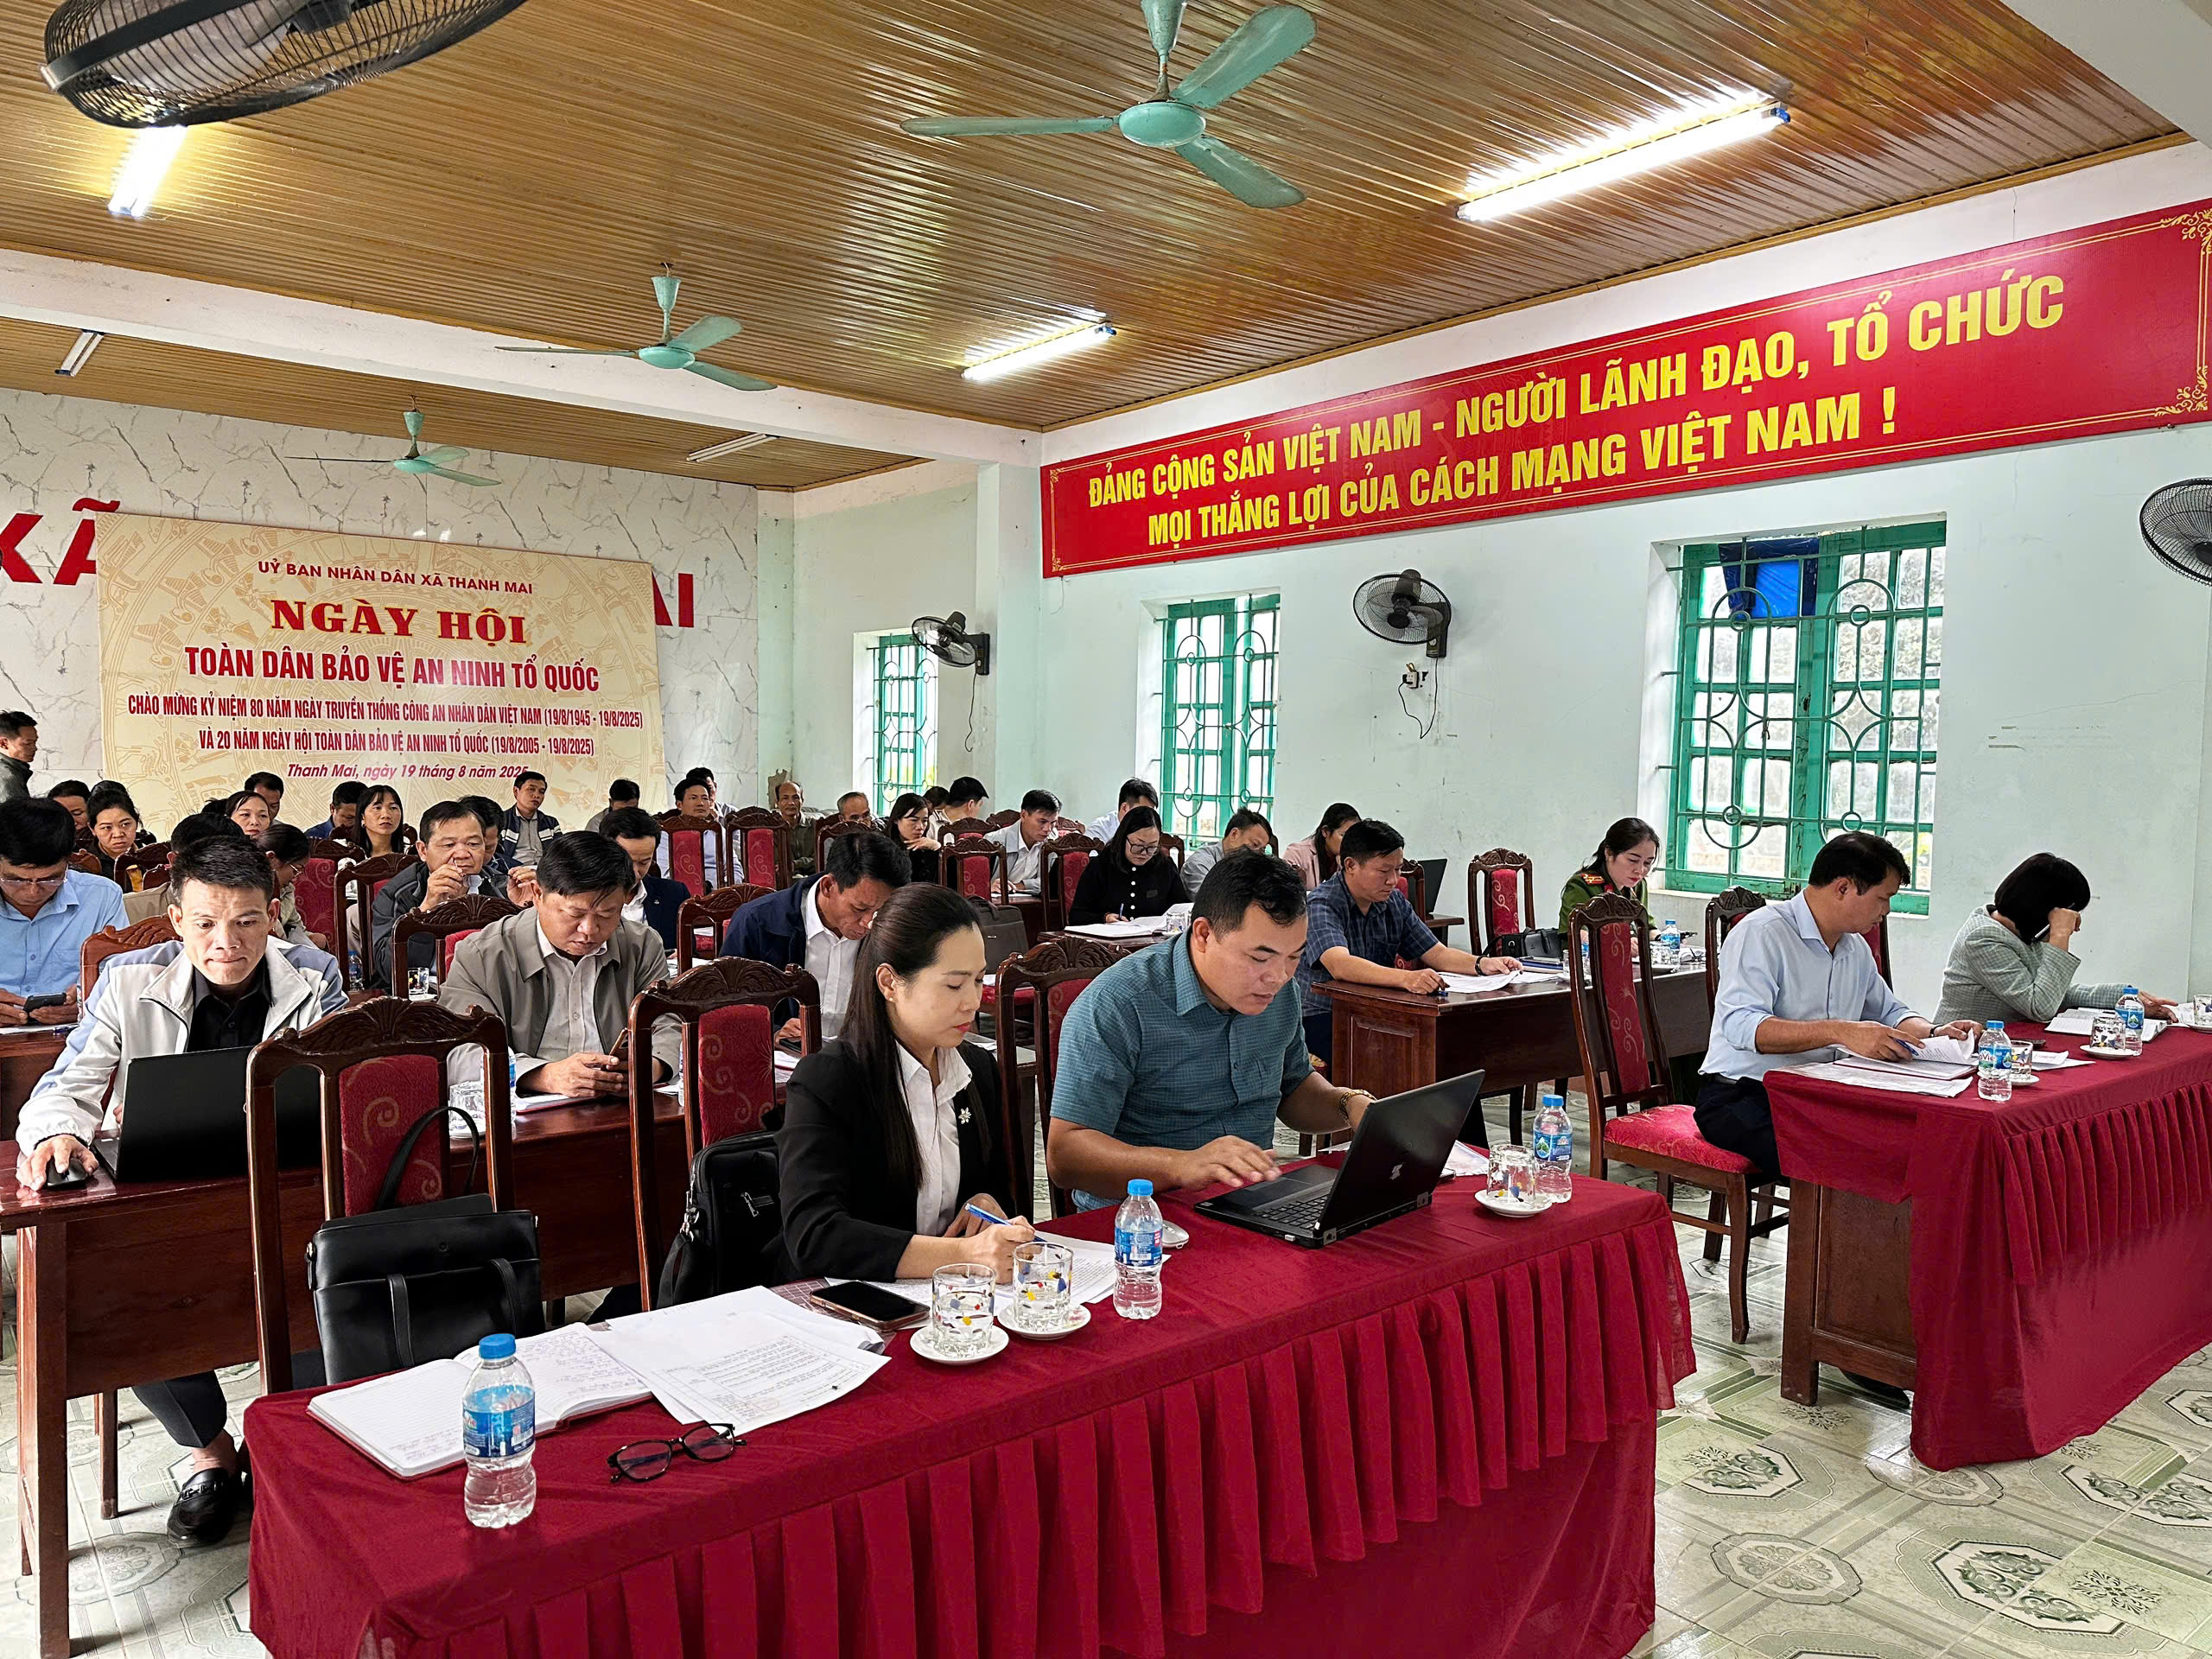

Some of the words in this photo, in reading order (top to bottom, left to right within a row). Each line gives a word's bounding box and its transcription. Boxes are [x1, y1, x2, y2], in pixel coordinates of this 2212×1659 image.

[1089, 462, 1146, 508] ĐẢNG
[1153, 455, 1214, 499] CỘNG
[1224, 432, 1274, 480] SẢN
[1283, 423, 1342, 474] VIỆT
[1350, 410, 1421, 458] NAM
[1433, 421, 1445, 430] -
[1456, 372, 1567, 438] NGƯỜI
[1580, 353, 1687, 415] LÃNH
[1701, 331, 1809, 395] ĐẠO,
[1827, 289, 1892, 367] TỔ
[1909, 269, 2063, 352] CHỨC
[1148, 510, 1191, 549] MỌI
[1198, 490, 1280, 538] THẮNG
[1288, 484, 1329, 530] LỢI
[1340, 462, 1399, 514] CỦA
[1410, 456, 1499, 506] CÁCH
[1511, 434, 1626, 493] MẠNG
[1640, 411, 1731, 473] VIỆT
[1746, 392, 1860, 454] NAM
[1882, 387, 1896, 435] !
[258, 558, 280, 574] UỶ
[287, 563, 321, 577] BAN
[328, 566, 375, 582] NHÂN
[381, 570, 415, 584] DÂN
[421, 572, 442, 587] XÃ
[448, 576, 499, 592] THANH
[505, 582, 532, 594] MAI
[270, 598, 418, 637] NGÀY
[436, 607, 527, 647] HỘI
[185, 642, 254, 677] TOÀN
[262, 645, 313, 679] DÂN
[322, 645, 370, 682] BẢO
[378, 652, 404, 689] VỆ
[413, 658, 445, 685] AN
[451, 659, 505, 688] NINH
[512, 654, 537, 690] TỔ
[544, 658, 599, 692] QUỐC
[129, 691, 159, 715] CHÀO
[163, 694, 197, 715] MỪNG
[201, 691, 214, 716] KỶ
[219, 695, 247, 721] NIỆM
[251, 698, 263, 717] 80
[266, 696, 291, 718] NĂM
[295, 697, 322, 719] NGÀY
[326, 696, 364, 720] TRUYỀN
[367, 696, 400, 721] THỐNG
[403, 700, 429, 721] CÔNG
[432, 703, 445, 722] AN
[448, 702, 474, 723] NHÂN
[477, 702, 496, 724] DÂN
[499, 705, 518, 727] VIỆT
[521, 707, 542, 725] NAM
[544, 709, 590, 727] (19/8/1945
[599, 710, 643, 728] 19/8/2025)
[200, 726, 214, 749] VÀ
[218, 730, 231, 749] 20
[234, 728, 259, 750] NĂM
[263, 728, 291, 750] NGÀY
[295, 729, 312, 753] HỘI
[315, 727, 342, 751] TOÀN
[346, 729, 366, 751] DÂN
[369, 728, 389, 752] BẢO
[391, 730, 404, 755] VỆ
[407, 734, 421, 752] AN
[423, 734, 447, 753] NINH
[449, 728, 461, 753] TỔ
[463, 729, 488, 754] QUỐC
[492, 737, 539, 754] (19/8/2005
[548, 738, 594, 756] 19/8/2025)
[288, 764, 328, 777] Thanh
[332, 764, 359, 779] Mai,
[364, 764, 397, 780] ngày
[401, 765, 416, 778] 19
[418, 765, 456, 780] tháng
[458, 766, 466, 778] 8
[469, 765, 497, 778] năm
